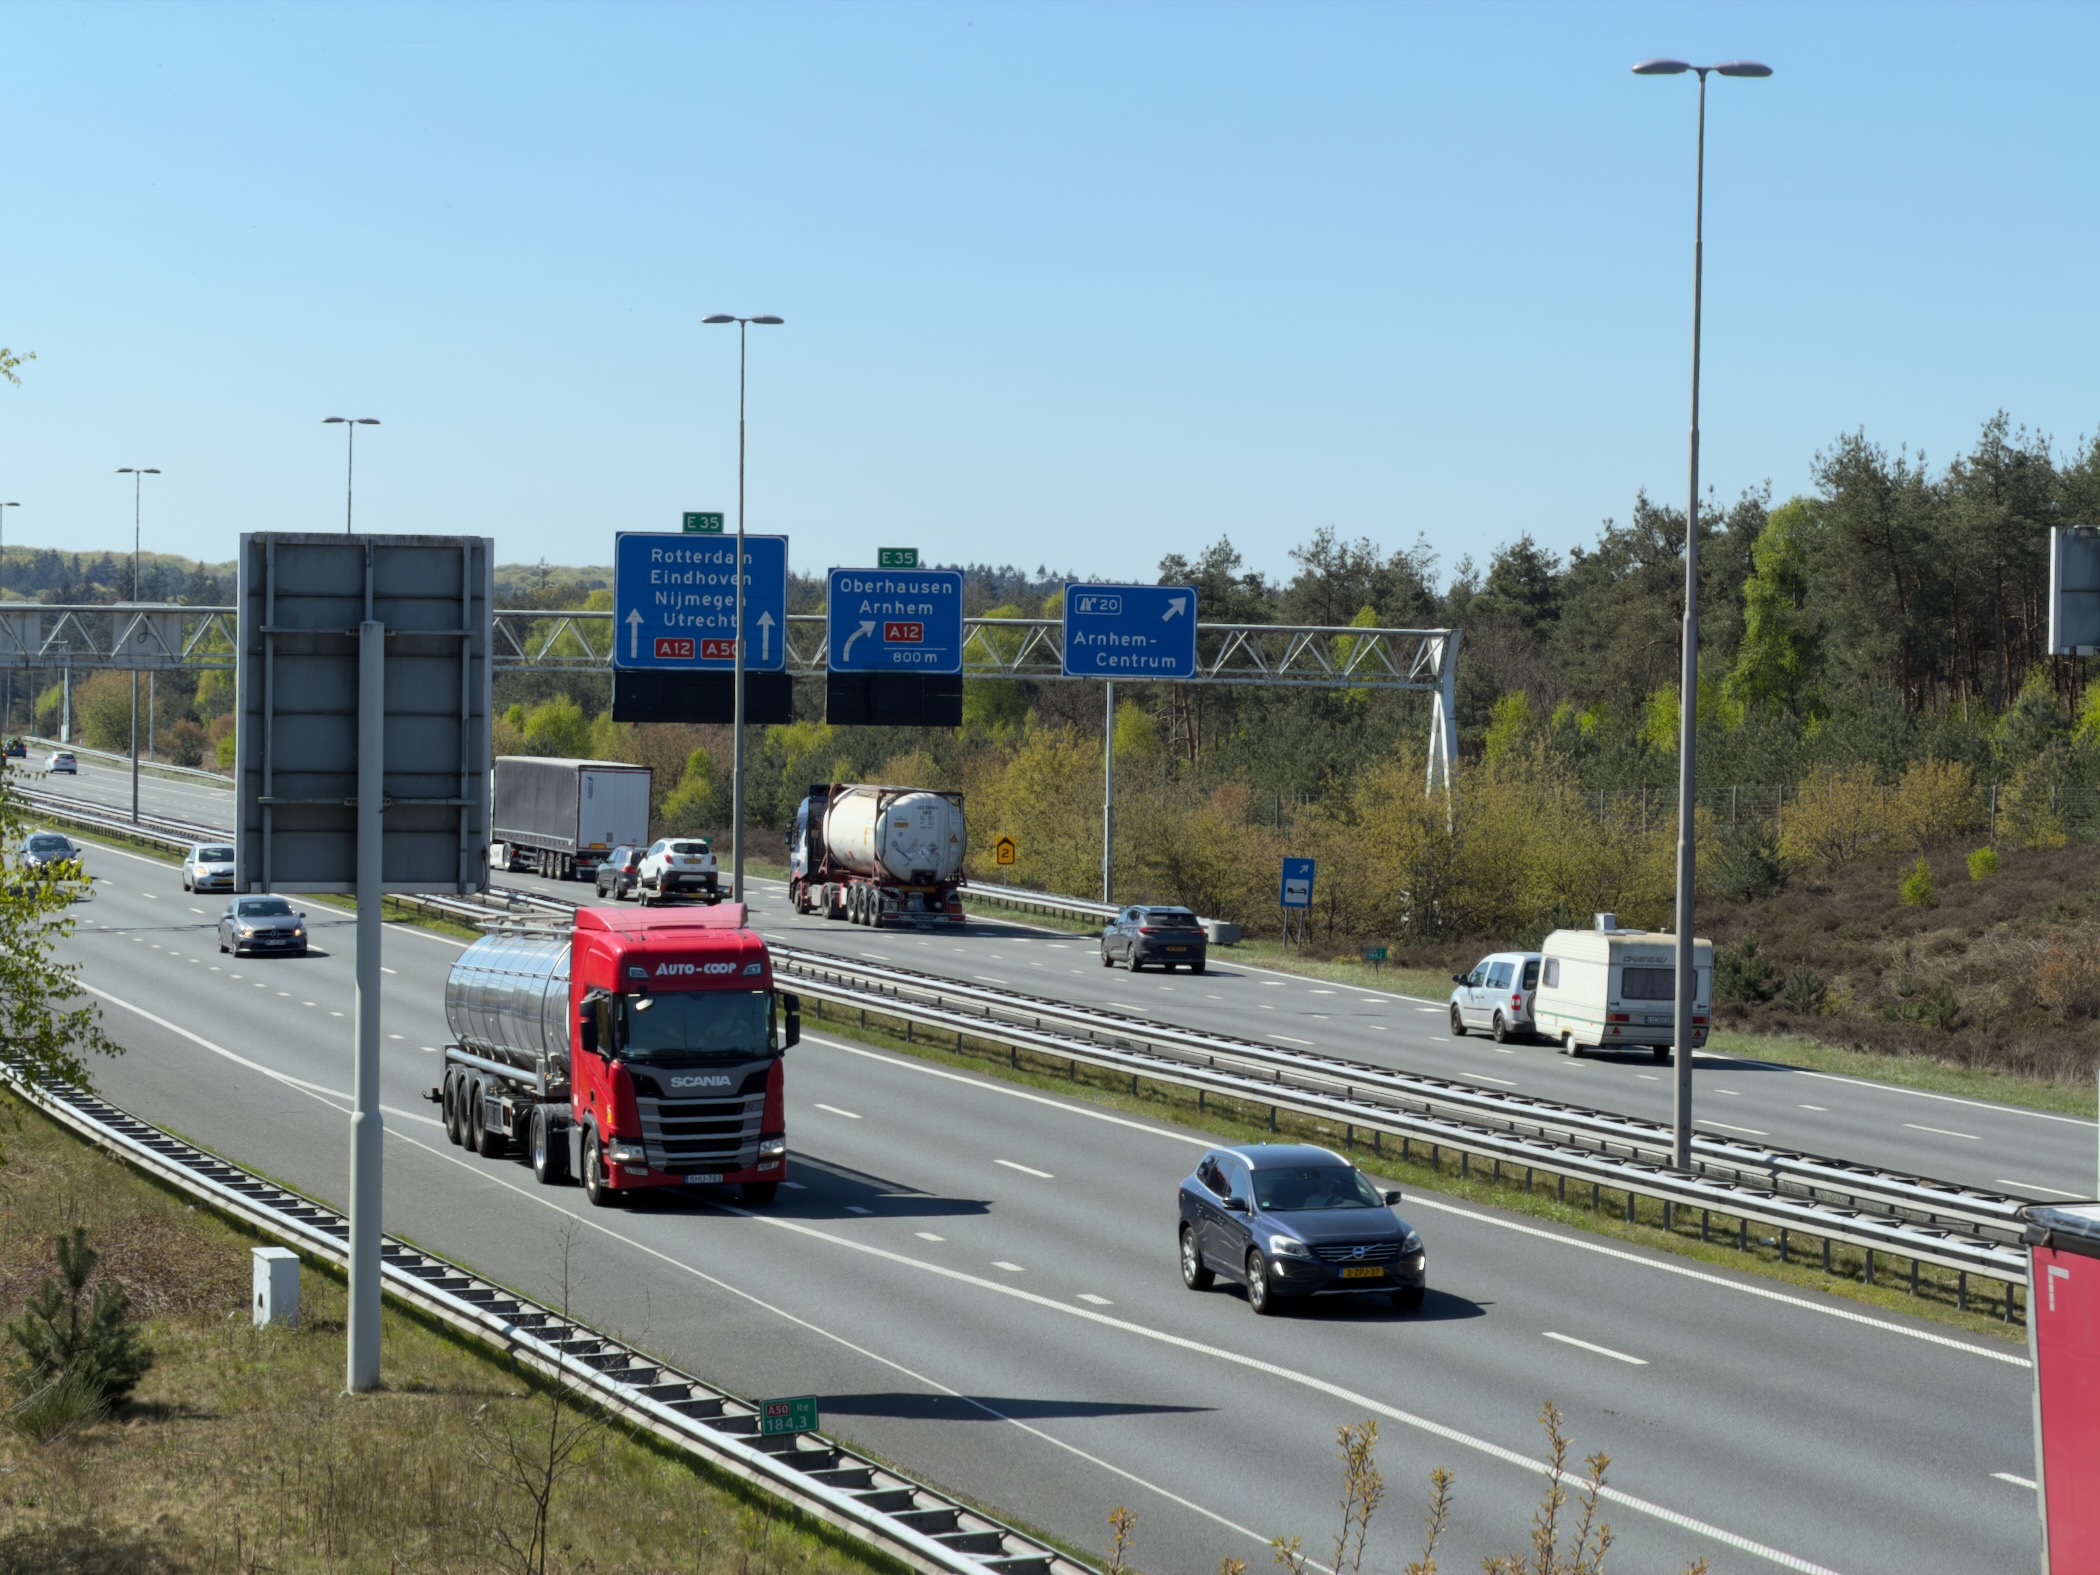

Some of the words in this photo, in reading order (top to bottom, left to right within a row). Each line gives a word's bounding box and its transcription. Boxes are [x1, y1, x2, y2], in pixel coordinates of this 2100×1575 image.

[651, 549, 752, 565] Rotterdam
[651, 570, 752, 586] Eindhoven
[840, 578, 952, 594] Oberhausen
[859, 600, 934, 615] Arnhem
[1099, 599, 1118, 611] 20
[664, 612, 737, 627] Utrecht
[889, 626, 920, 639] A12
[1073, 631, 1157, 647] Arnhem-
[660, 642, 691, 655] A12
[892, 652, 921, 663] 800
[924, 653, 938, 664] m
[1096, 652, 1177, 668] Centrum
[1001, 848, 1009, 858] 2
[1622, 955, 1668, 964] CHATEAU
[655, 962, 737, 976] AUTO-COOP
[670, 1075, 732, 1088] SCANIA
[767, 1404, 789, 1416] A50
[796, 1403, 809, 1413] Re
